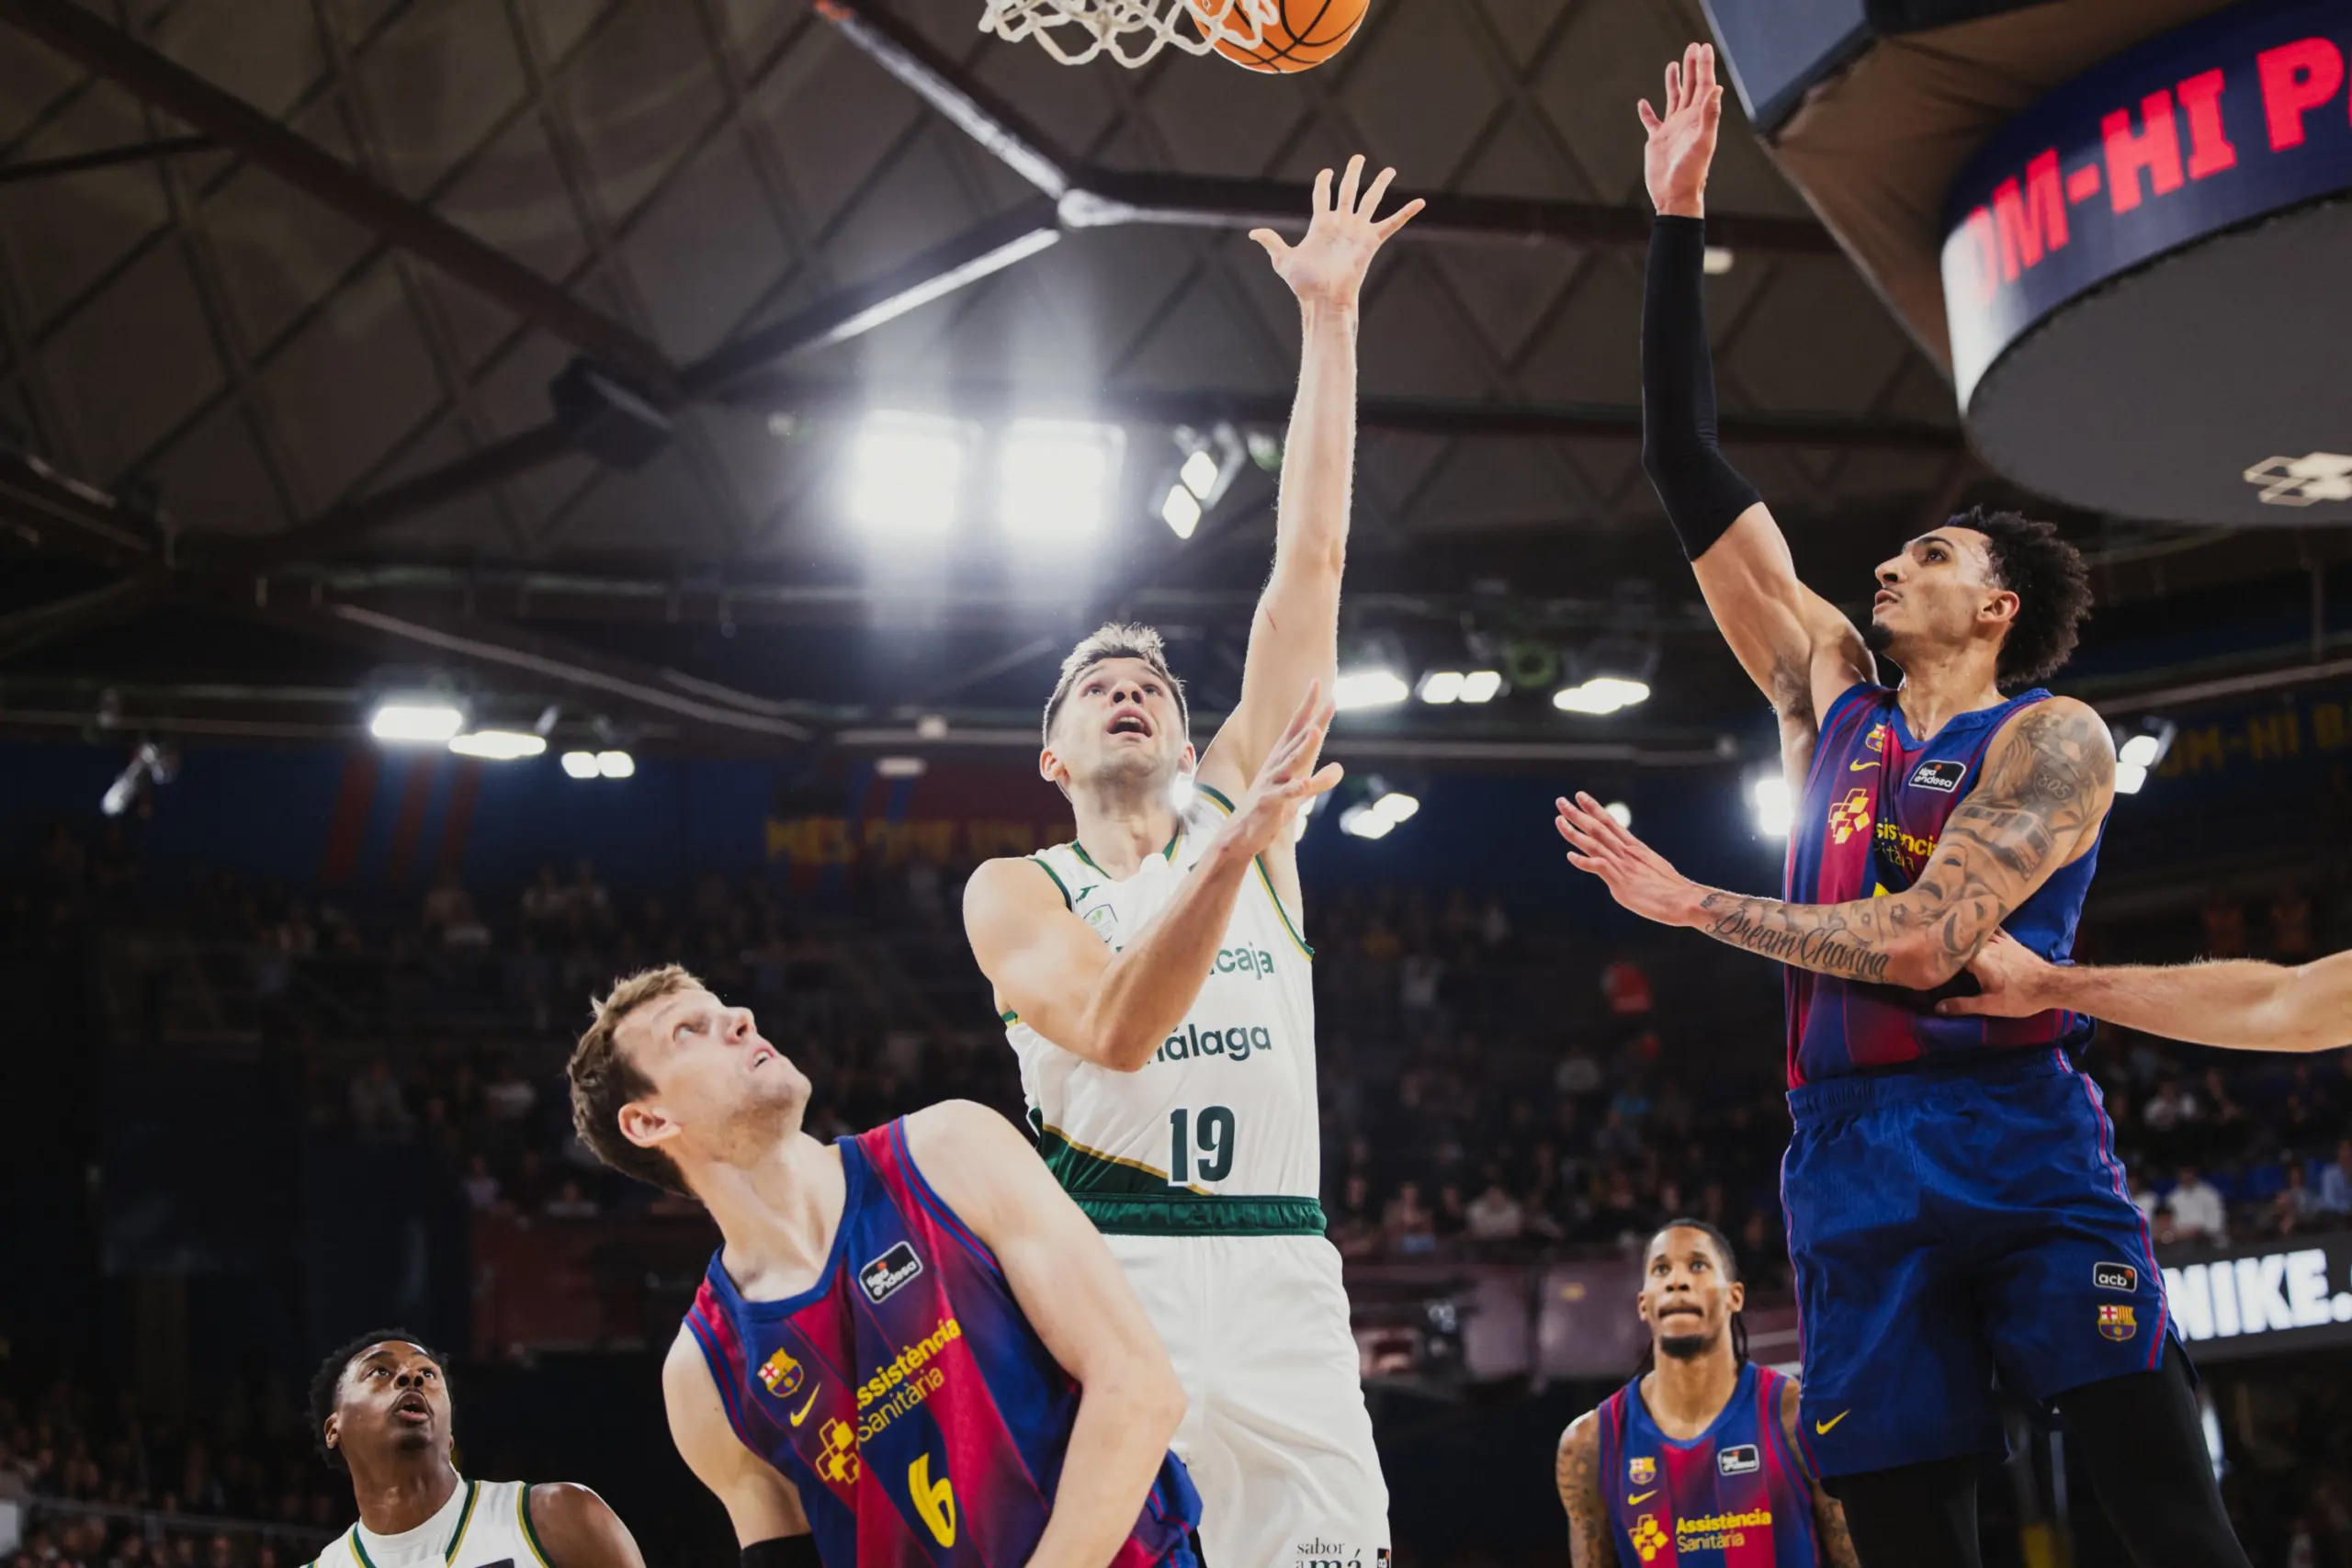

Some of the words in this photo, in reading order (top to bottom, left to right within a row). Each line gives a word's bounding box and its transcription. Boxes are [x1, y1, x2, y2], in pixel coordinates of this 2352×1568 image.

[2256, 36, 2352, 152] P
[1914, 775, 1953, 788] endesa
[1705, 909, 1800, 960] Dream
[1209, 940, 1275, 980] caja
[1169, 1105, 1236, 1184] 19
[2098, 1271, 2128, 1287] acb
[857, 1317, 962, 1411] ssistència
[857, 1366, 945, 1442] Sanitària
[908, 1452, 956, 1549] 6
[1675, 1507, 1772, 1535] Assistència
[1296, 1537, 1346, 1554] sabor
[1676, 1529, 1745, 1553] Sanitària
